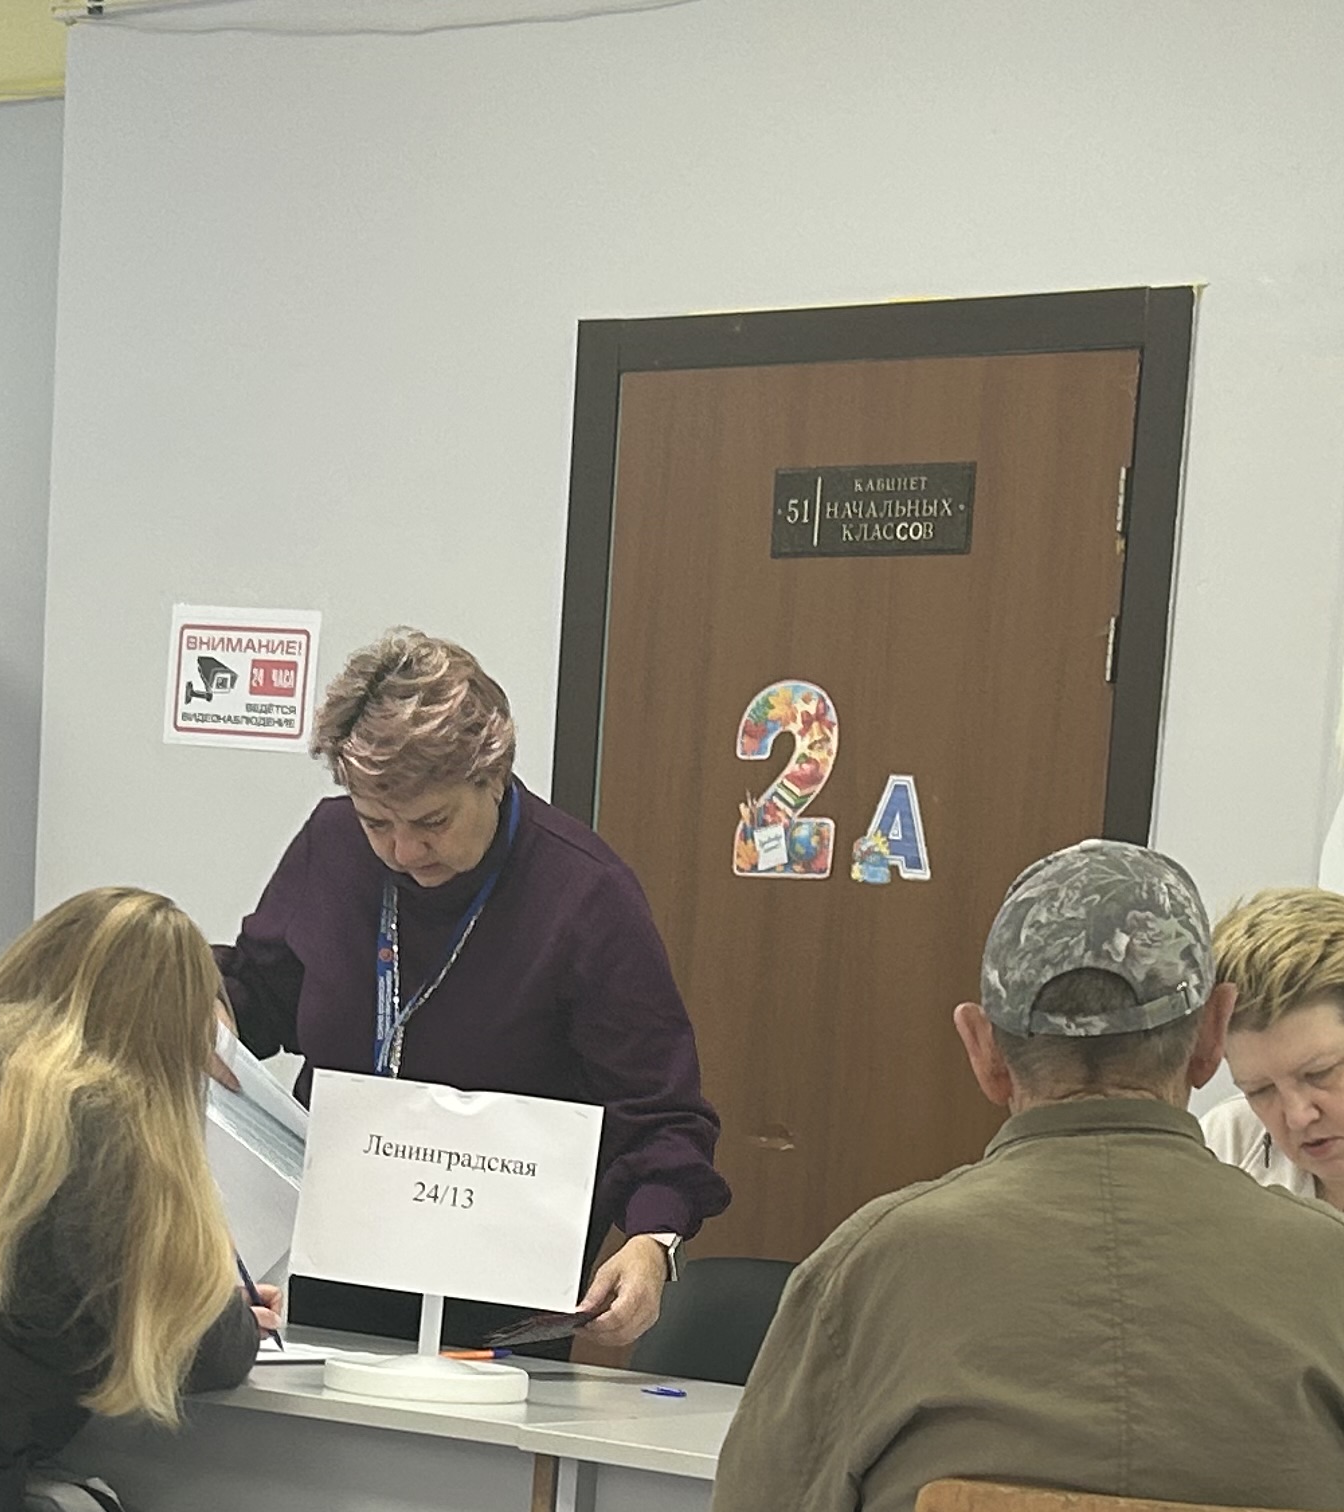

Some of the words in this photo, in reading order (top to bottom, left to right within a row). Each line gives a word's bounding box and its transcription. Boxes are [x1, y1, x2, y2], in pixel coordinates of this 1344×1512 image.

[853, 476, 928, 492] КАБИНЕТ
[786, 498, 809, 525] 51
[825, 498, 954, 520] НАЧАЛЬНЫХ
[841, 521, 935, 542] КЛАССОВ
[186, 635, 303, 656] ВНИМАНИЕ!
[733, 680, 839, 879] 2
[362, 1134, 538, 1178] Ленинградская
[412, 1181, 475, 1209] 24/13
